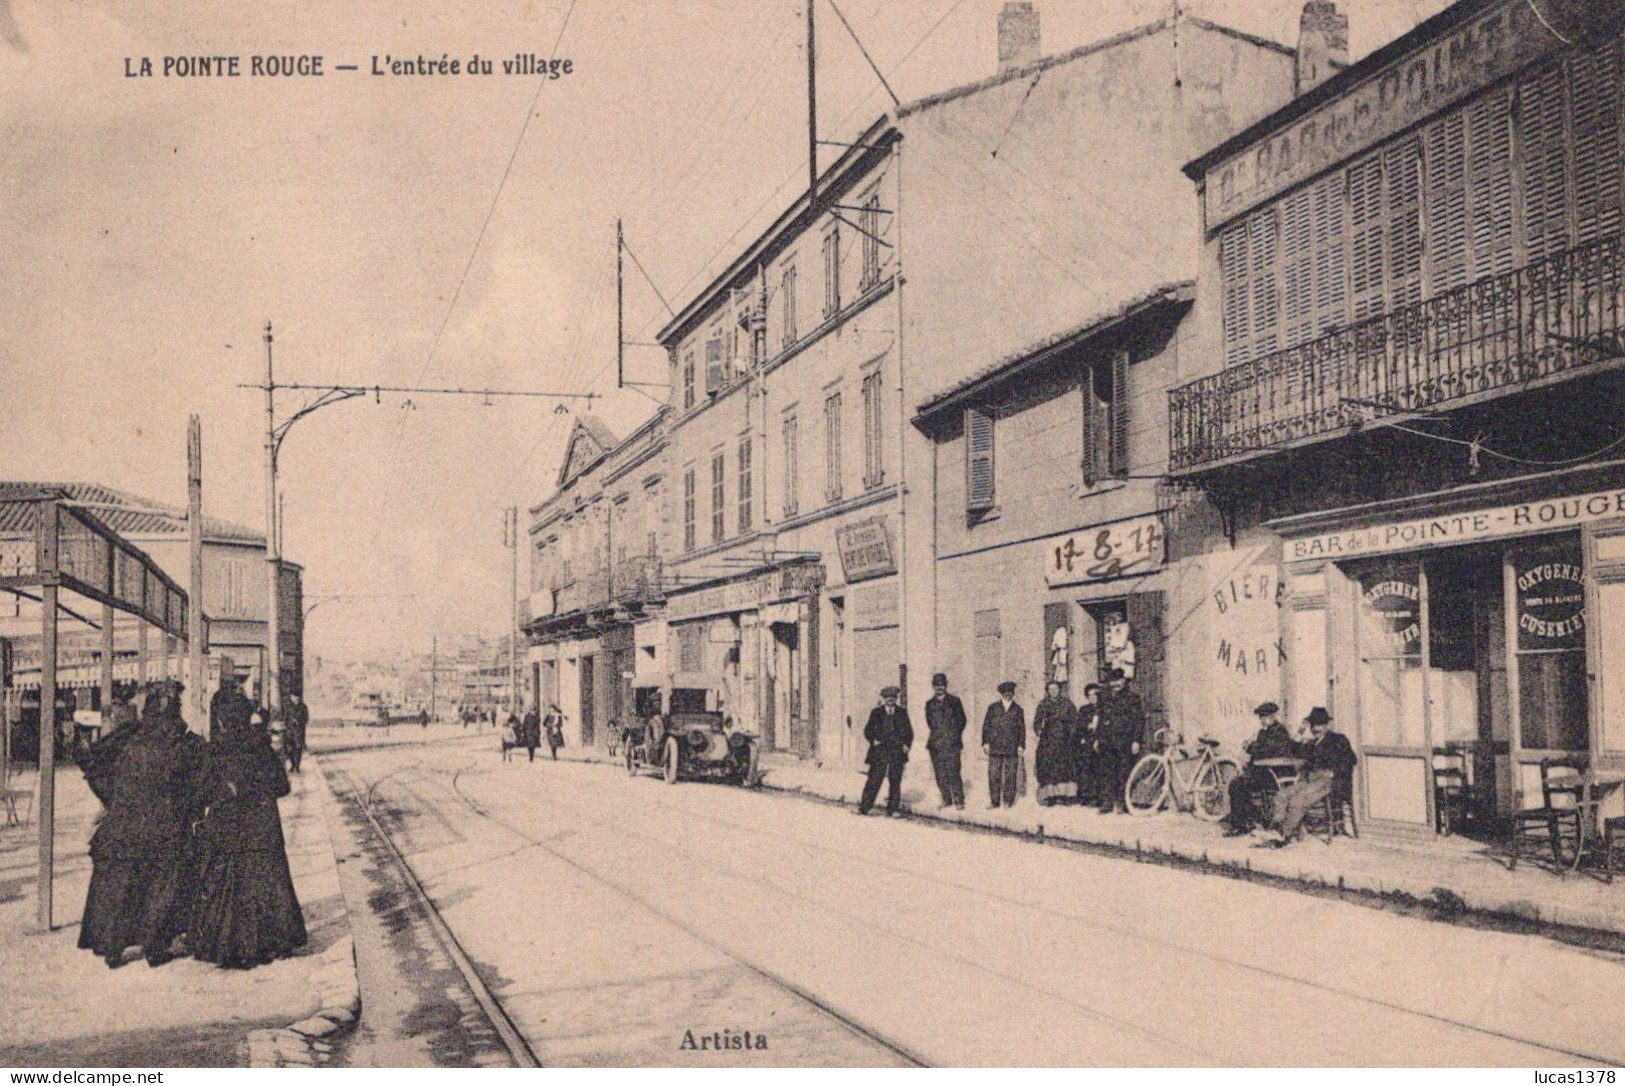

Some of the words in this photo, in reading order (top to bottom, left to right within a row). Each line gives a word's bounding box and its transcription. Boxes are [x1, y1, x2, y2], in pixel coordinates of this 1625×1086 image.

[1294, 535, 1343, 558] BAR
[1347, 534, 1362, 550] de
[1367, 531, 1379, 547] la
[1214, 573, 1287, 615] BIERE
[1216, 637, 1288, 676] MARX
